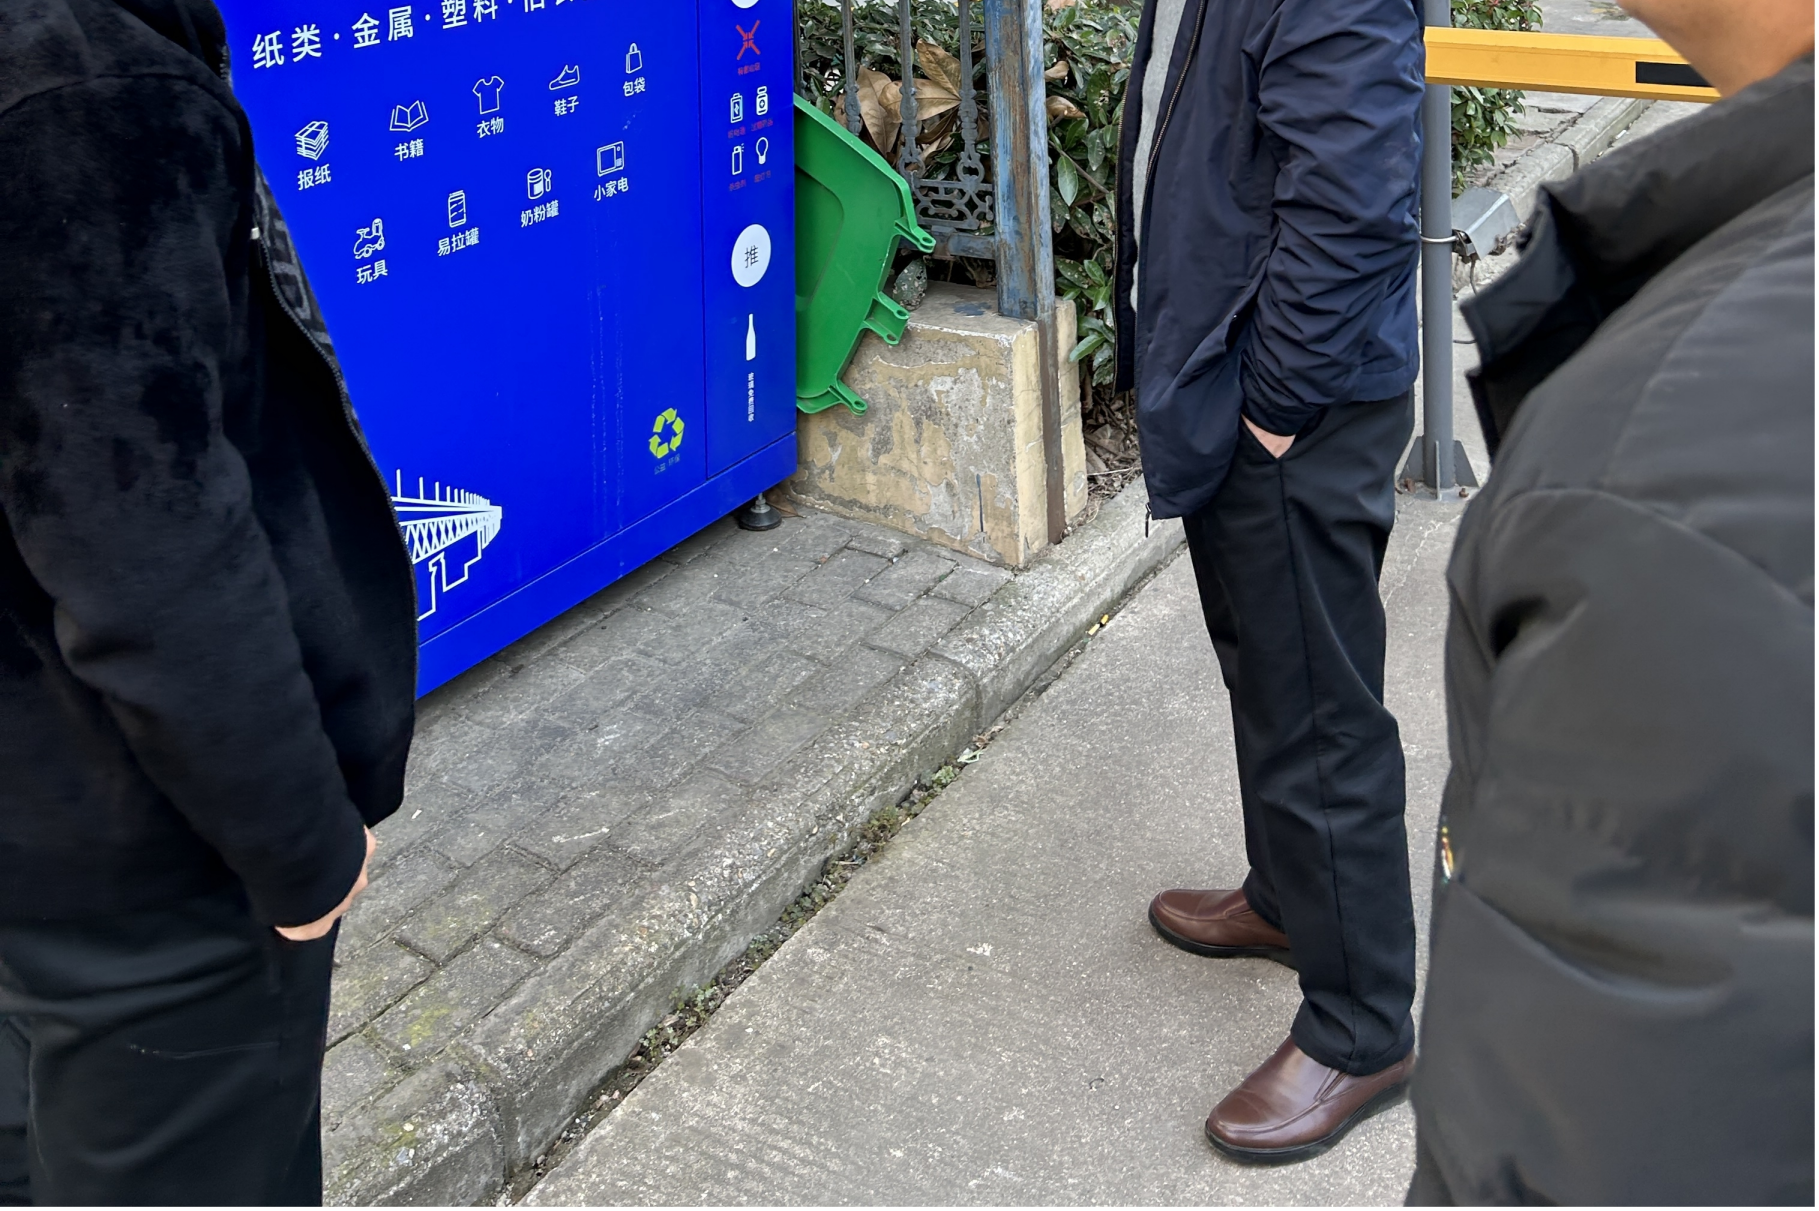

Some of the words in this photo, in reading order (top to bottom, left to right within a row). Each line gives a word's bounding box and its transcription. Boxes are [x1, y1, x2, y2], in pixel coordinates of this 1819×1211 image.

[622, 77, 646, 97] 包袋
[554, 96, 579, 116] 鞋子
[476, 116, 504, 139] 衣物
[393, 138, 424, 161] 书籍
[297, 163, 332, 191] 报纸
[594, 176, 629, 201] 小家电
[520, 200, 559, 228] 奶粉罐
[437, 228, 479, 256] 易拉罐
[745, 245, 759, 268] 推
[356, 259, 388, 285] 玩具
